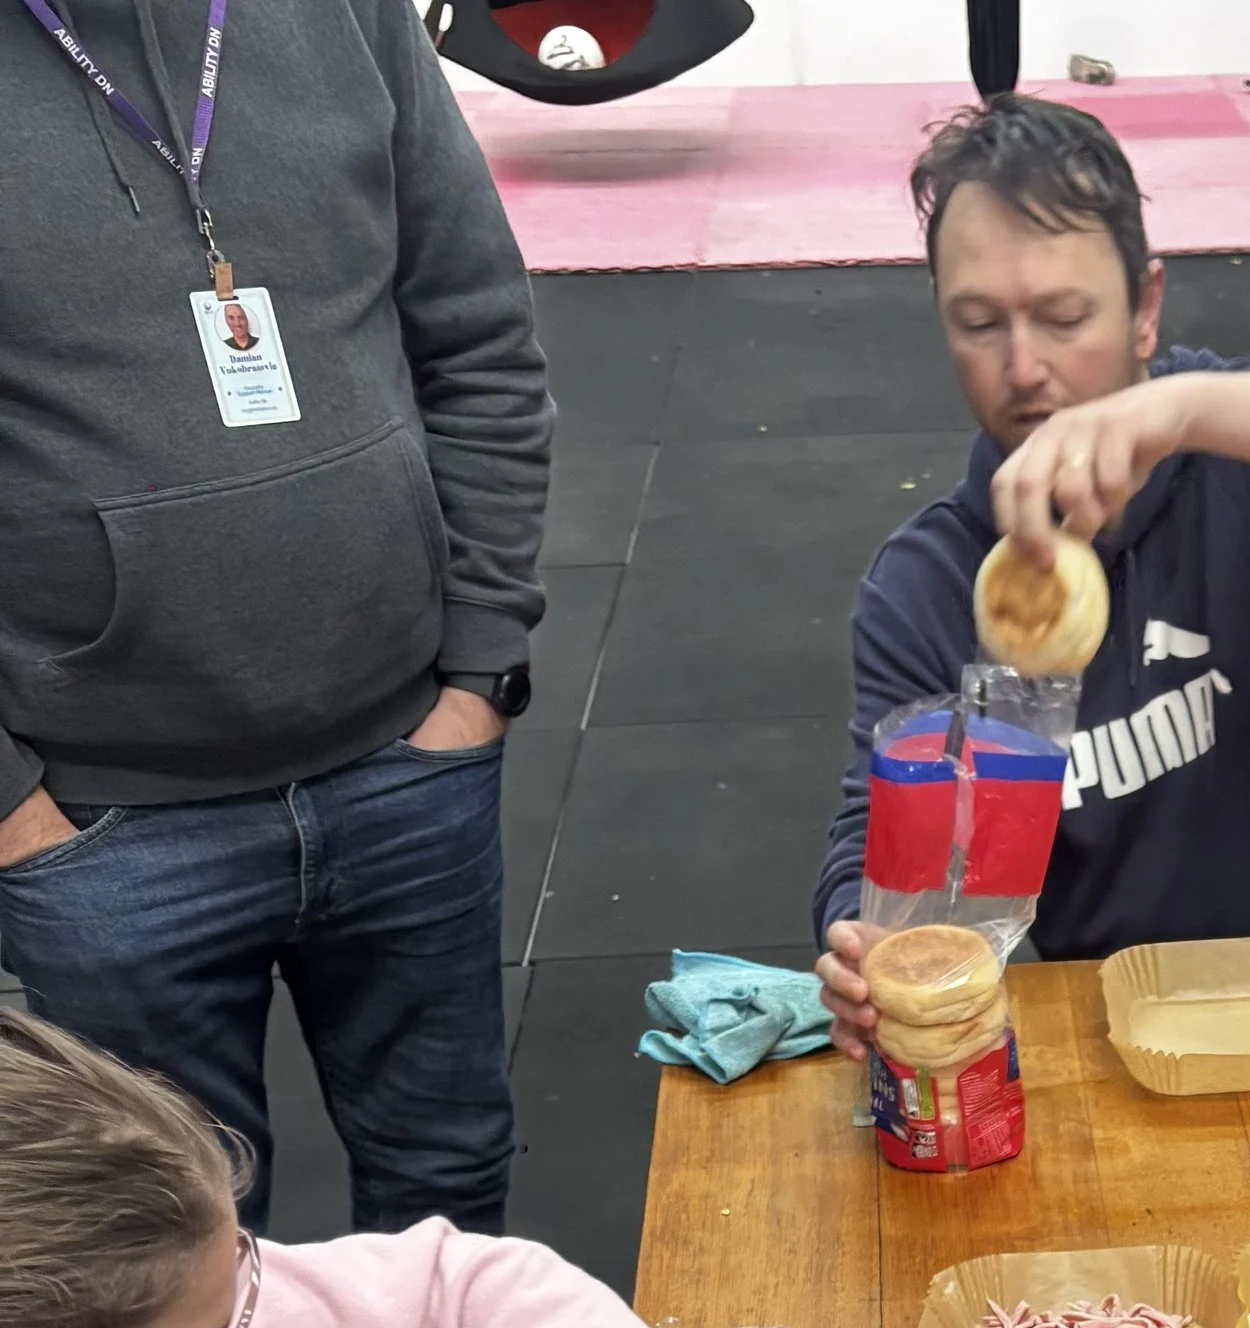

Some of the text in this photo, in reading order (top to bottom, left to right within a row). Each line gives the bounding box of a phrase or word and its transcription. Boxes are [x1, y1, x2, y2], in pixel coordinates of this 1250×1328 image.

[53, 28, 115, 96] ABILITY DN
[201, 27, 221, 98] ABILITY DN
[1061, 671, 1217, 811] PUMA
